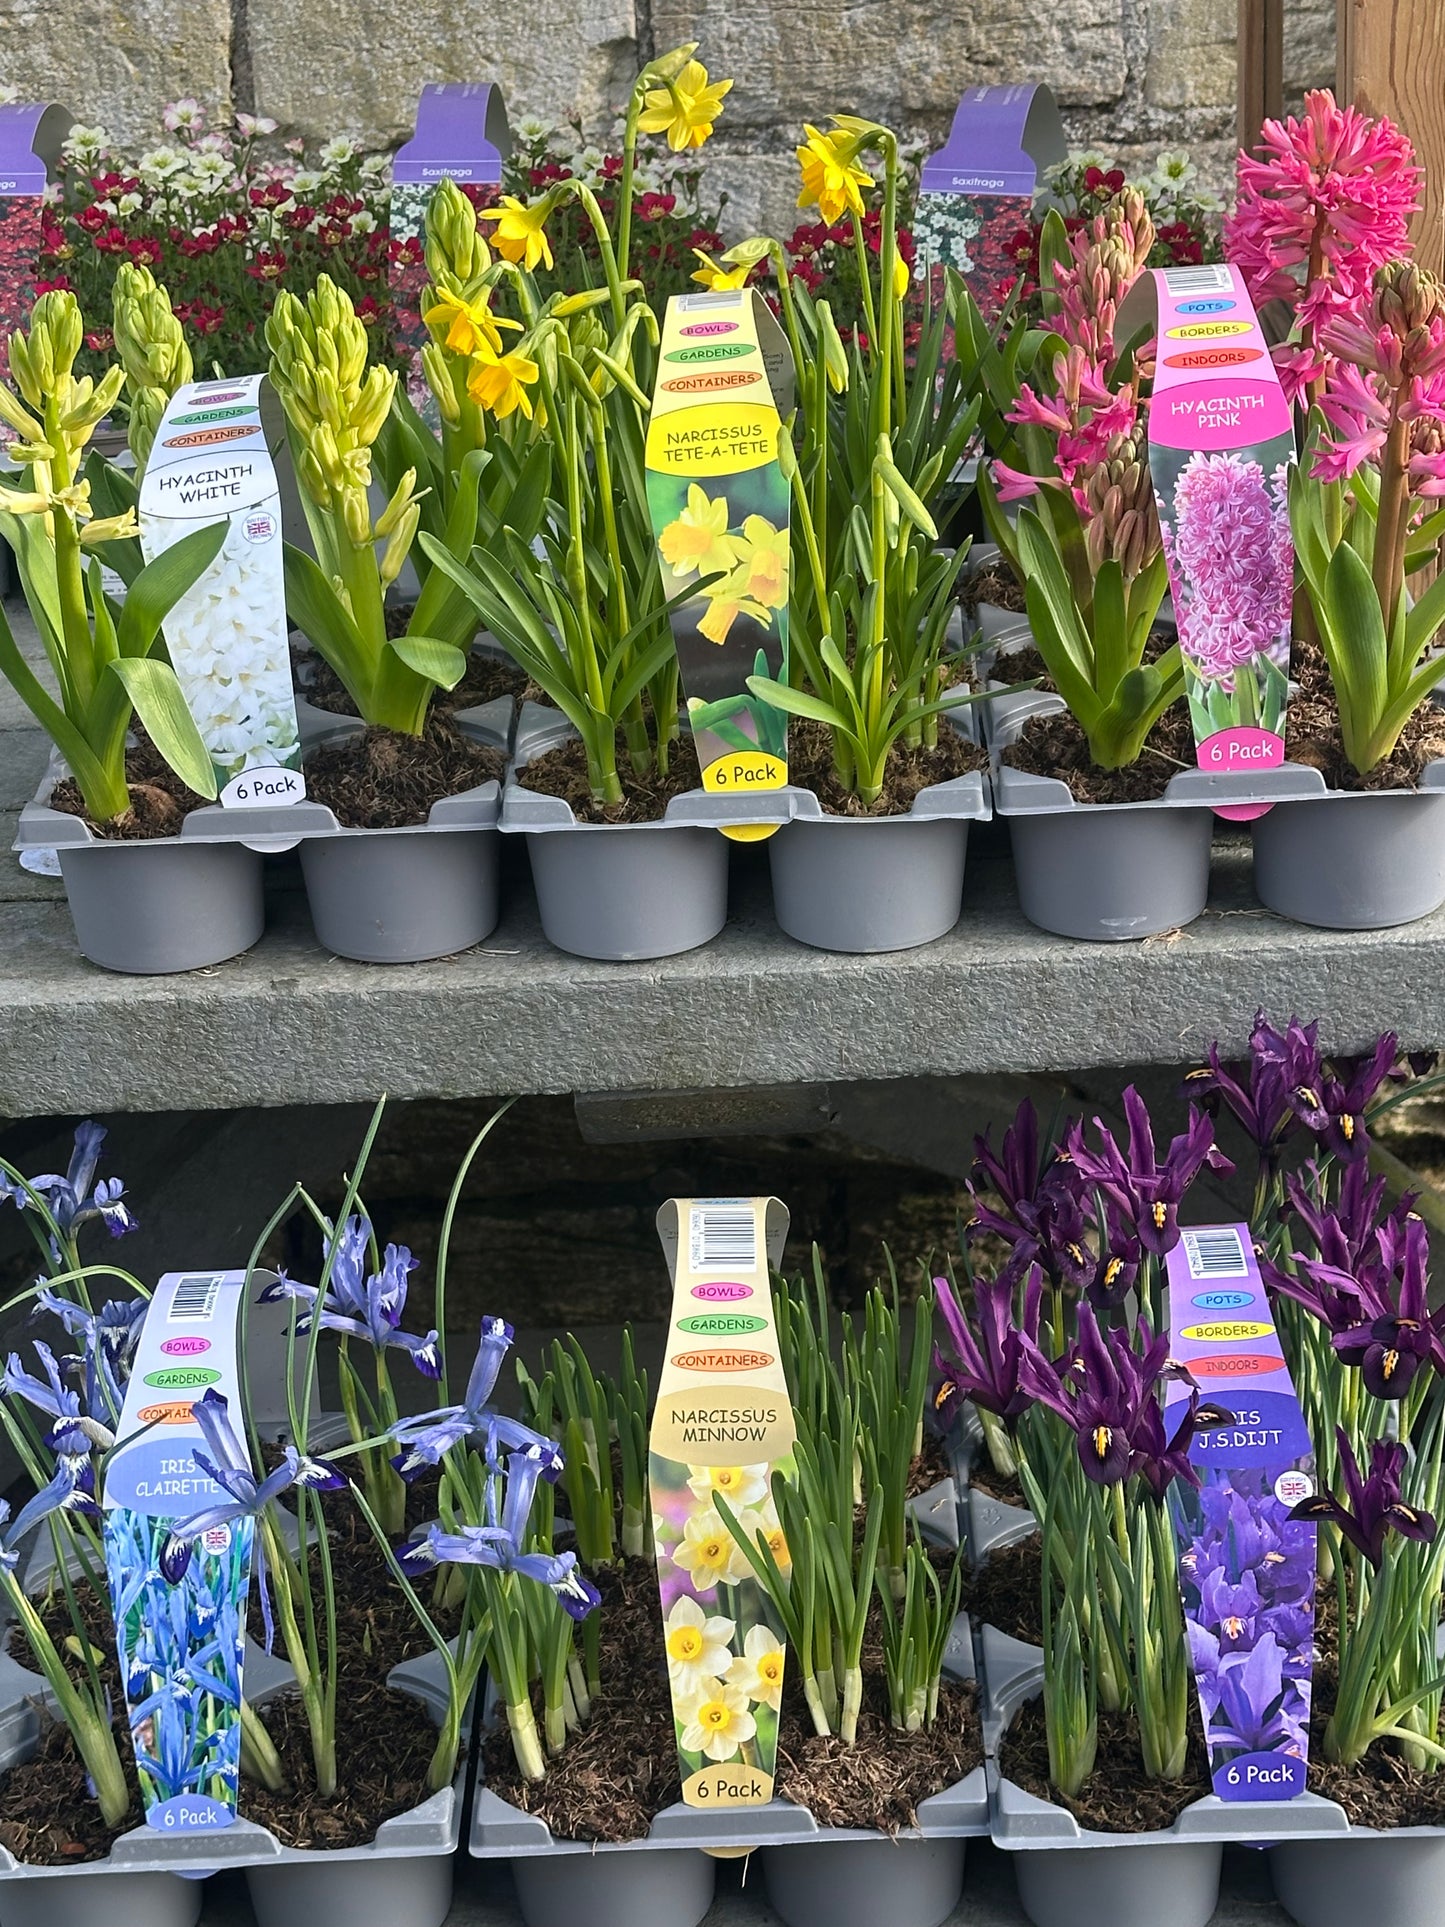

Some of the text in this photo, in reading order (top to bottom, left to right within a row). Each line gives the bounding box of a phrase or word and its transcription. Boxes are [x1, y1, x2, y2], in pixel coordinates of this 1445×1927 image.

[422, 168, 473, 178] Saxifraga
[952, 177, 1005, 189] Saxifraga
[1188, 303, 1224, 312] POTS
[686, 324, 733, 335] BOWLS
[1180, 325, 1240, 338] BORDERS
[680, 347, 741, 361] GARDENS
[1182, 352, 1246, 367] INDOORS
[668, 374, 756, 391] CONTAINERS
[1171, 394, 1265, 416] HYACINTH
[184, 408, 244, 423] GARDENS
[1198, 412, 1241, 428] PINK
[169, 427, 254, 446] CONTAINERS
[667, 425, 762, 445] NARCISSUS
[664, 440, 768, 462] TETE-A-TETE
[160, 464, 252, 490] HYACINTH
[180, 482, 240, 504] WHITE
[1211, 739, 1273, 762] 6 Pack
[716, 762, 776, 785] 6 Pack
[237, 776, 297, 800] 6 Pack
[698, 1287, 746, 1297] BOWLS
[1206, 1295, 1242, 1305] POTS
[690, 1319, 755, 1331] GARDENS
[1196, 1325, 1258, 1338] BORDERS
[166, 1341, 206, 1352] BOWLS
[677, 1354, 768, 1366] CONTAINERS
[1205, 1359, 1259, 1372] INDOORS
[157, 1373, 209, 1386] GARDENS
[672, 1409, 777, 1425] NARCISSUS
[683, 1426, 767, 1442] MINNOW
[1199, 1430, 1282, 1449] J.S.DIJT
[160, 1459, 196, 1475] IRIS
[136, 1478, 219, 1497] CLAIRETTE
[1227, 1763, 1294, 1785] 6 Pack
[697, 1779, 762, 1798] 6 Pack
[164, 1806, 217, 1827] 6 Pack
